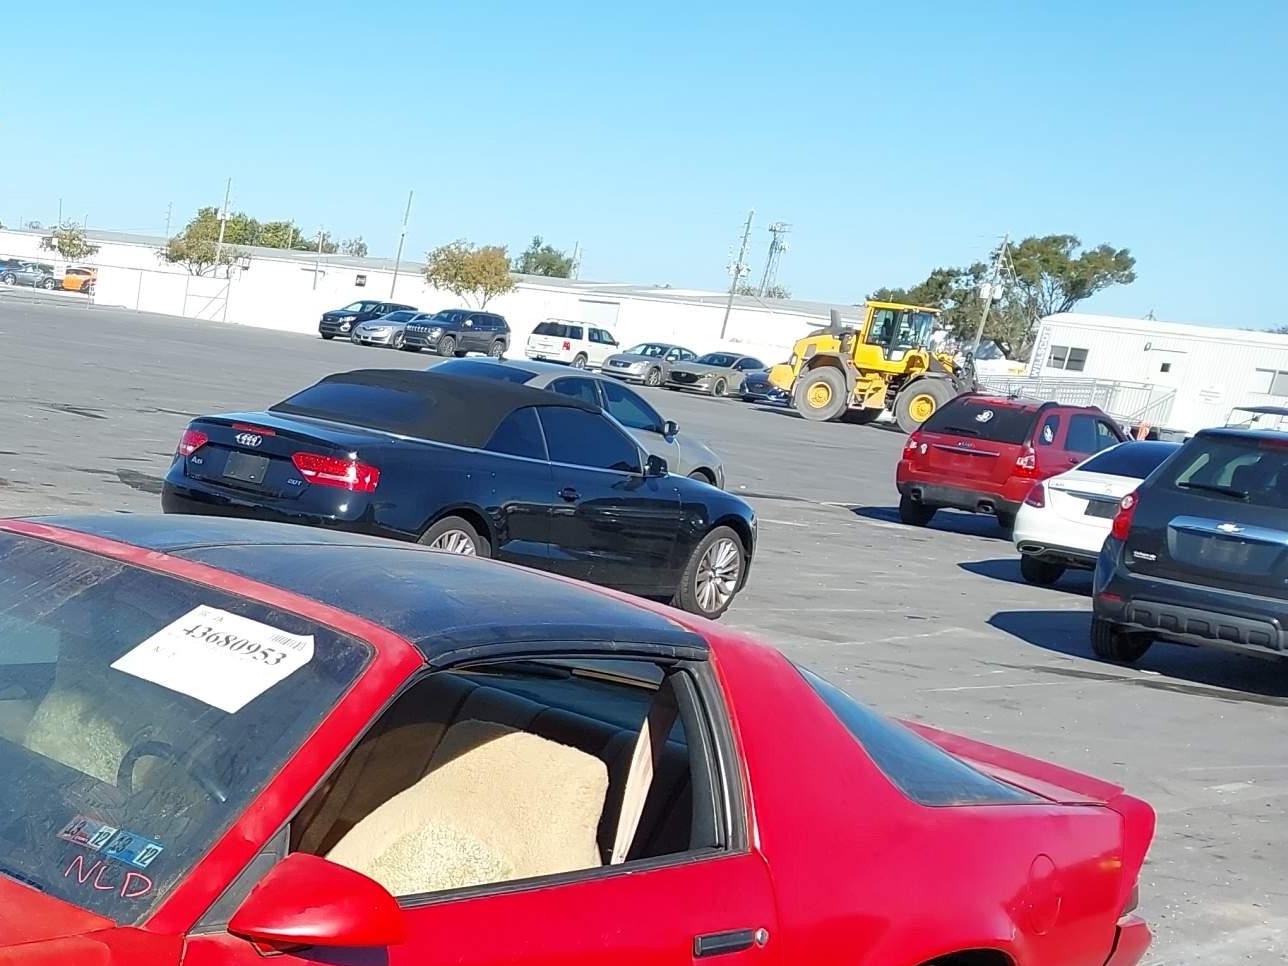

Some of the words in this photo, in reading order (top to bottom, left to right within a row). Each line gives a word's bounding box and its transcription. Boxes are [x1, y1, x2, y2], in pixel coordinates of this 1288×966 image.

[182, 624, 288, 667] 43680953
[91, 831, 111, 847] 12
[137, 847, 159, 866] 12
[64, 855, 153, 898] NLD
